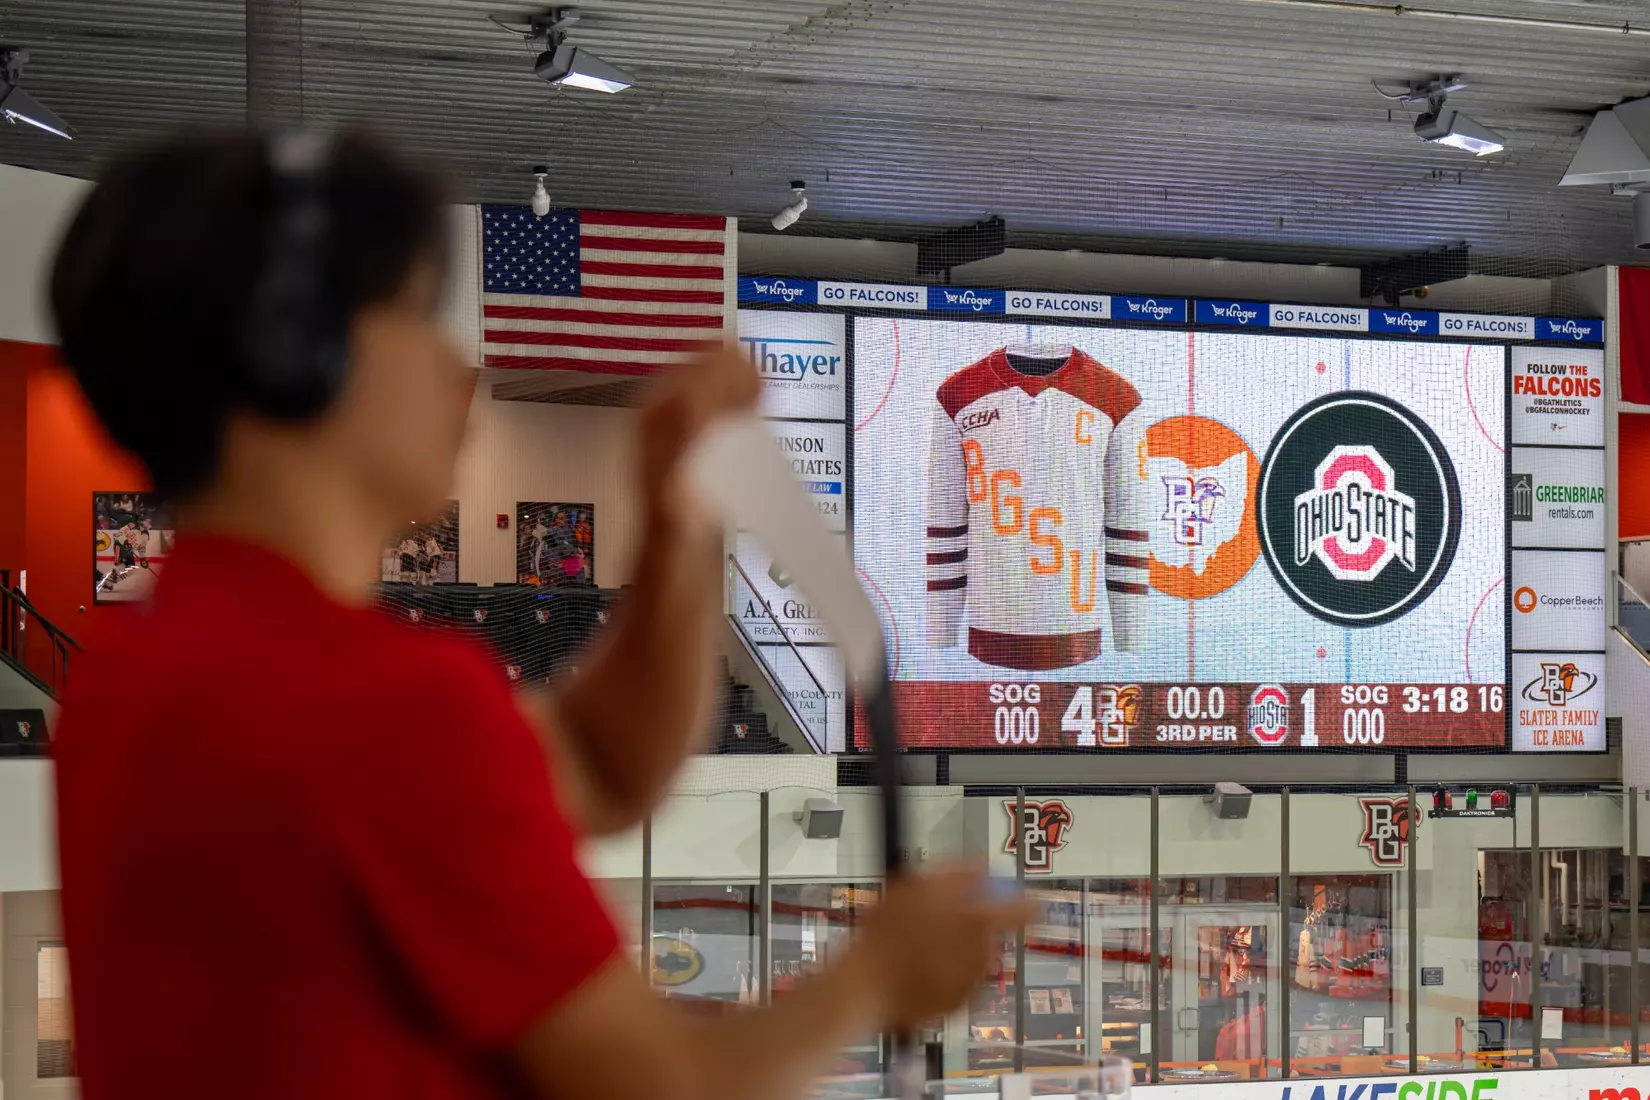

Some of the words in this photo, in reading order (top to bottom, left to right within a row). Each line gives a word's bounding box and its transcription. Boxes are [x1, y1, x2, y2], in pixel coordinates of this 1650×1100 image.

[769, 280, 804, 302] Kroger
[823, 287, 845, 300] GO
[849, 289, 919, 303] FALCONS!
[959, 290, 993, 311] Kroger
[1011, 297, 1032, 309] GO
[1036, 298, 1103, 312] FALCONS!
[1141, 299, 1173, 320] Kroger
[1225, 303, 1257, 324] Kroger
[1274, 310, 1294, 322] GO
[1298, 311, 1361, 325] FALCONS!
[1397, 312, 1427, 332] Kroger
[1444, 319, 1463, 330] GO
[1467, 320, 1527, 333] FALCONS!
[1562, 320, 1592, 340] Kroger
[739, 336, 841, 380] Thayer
[1527, 363, 1567, 375] FOLLOW
[1569, 365, 1588, 375] THE
[791, 383, 840, 391] DEALERSHIPS
[1514, 375, 1602, 397] FALCONS
[1525, 406, 1591, 415] @BGFALCONHOCKEY
[1533, 398, 1582, 407] @BGATHLETICS
[961, 408, 1000, 432] CCHA
[1075, 409, 1094, 444] C
[773, 436, 824, 453] HNSON
[790, 459, 842, 475] CIATES
[813, 483, 833, 492] LAW
[1535, 485, 1605, 503] GREENBRIAR
[1548, 505, 1594, 519] rentals.com
[783, 599, 823, 619] GRE
[1540, 595, 1604, 608] CopperBeech
[989, 684, 1041, 704] SOG
[1166, 686, 1225, 719] 00.0
[1340, 685, 1389, 704] SOG
[1402, 686, 1469, 713] 3:18
[1478, 686, 1503, 713] 16
[994, 706, 1040, 744] 000
[1061, 686, 1096, 746] 4
[1300, 688, 1319, 746] 1
[1342, 708, 1385, 744] 000
[1519, 709, 1558, 726] SLATER
[1562, 710, 1599, 726] FAMILY
[1156, 725, 1196, 741] 3RD
[1198, 725, 1237, 741] PER
[1533, 729, 1549, 745] ICE
[1552, 729, 1585, 746] ARENA
